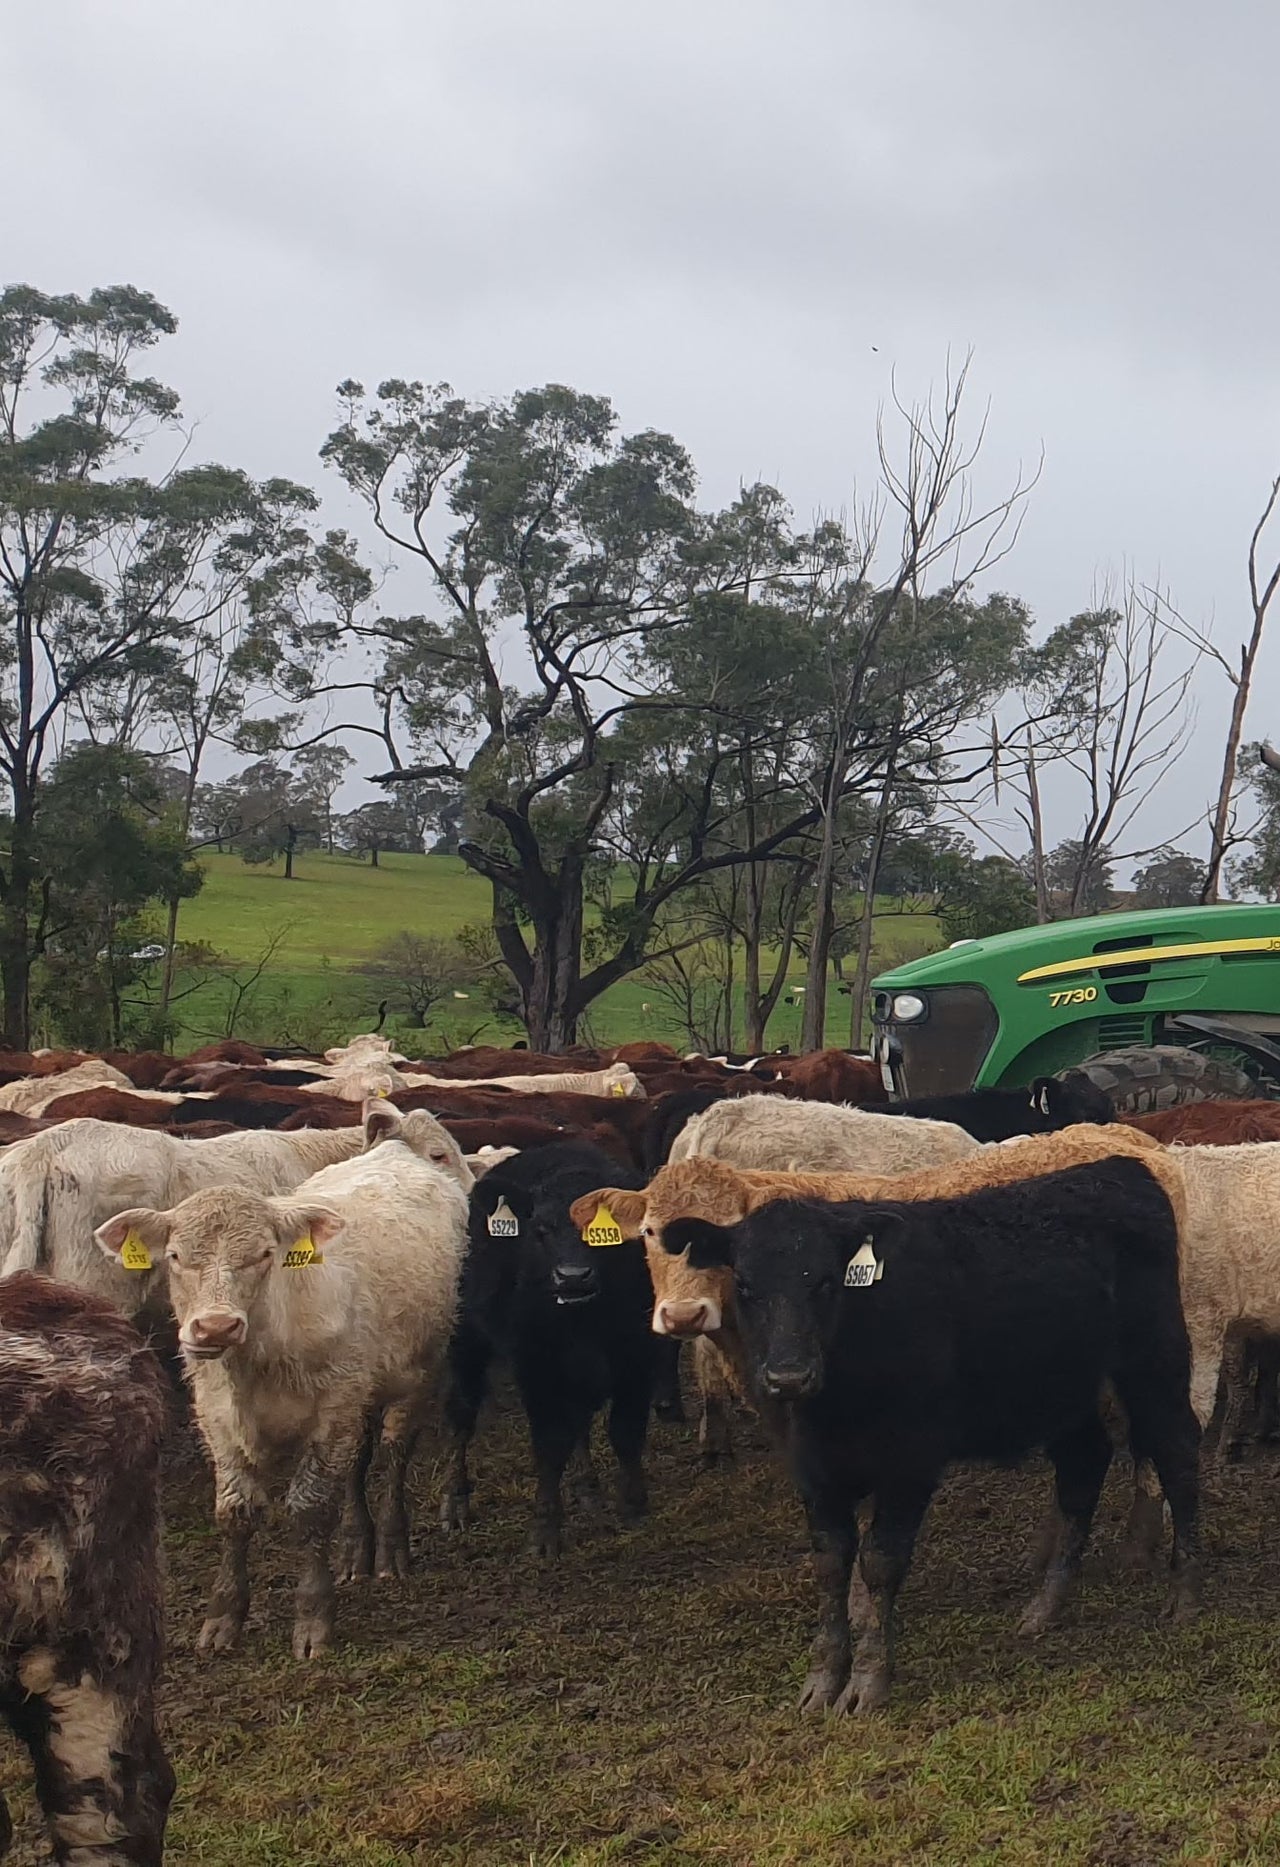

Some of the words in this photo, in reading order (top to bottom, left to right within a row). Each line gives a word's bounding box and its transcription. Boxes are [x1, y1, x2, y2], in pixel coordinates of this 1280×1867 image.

[1048, 986, 1097, 1008] 7730
[491, 1219, 517, 1236] S5229
[588, 1227, 621, 1244] S5358
[846, 1264, 876, 1285] S5057
